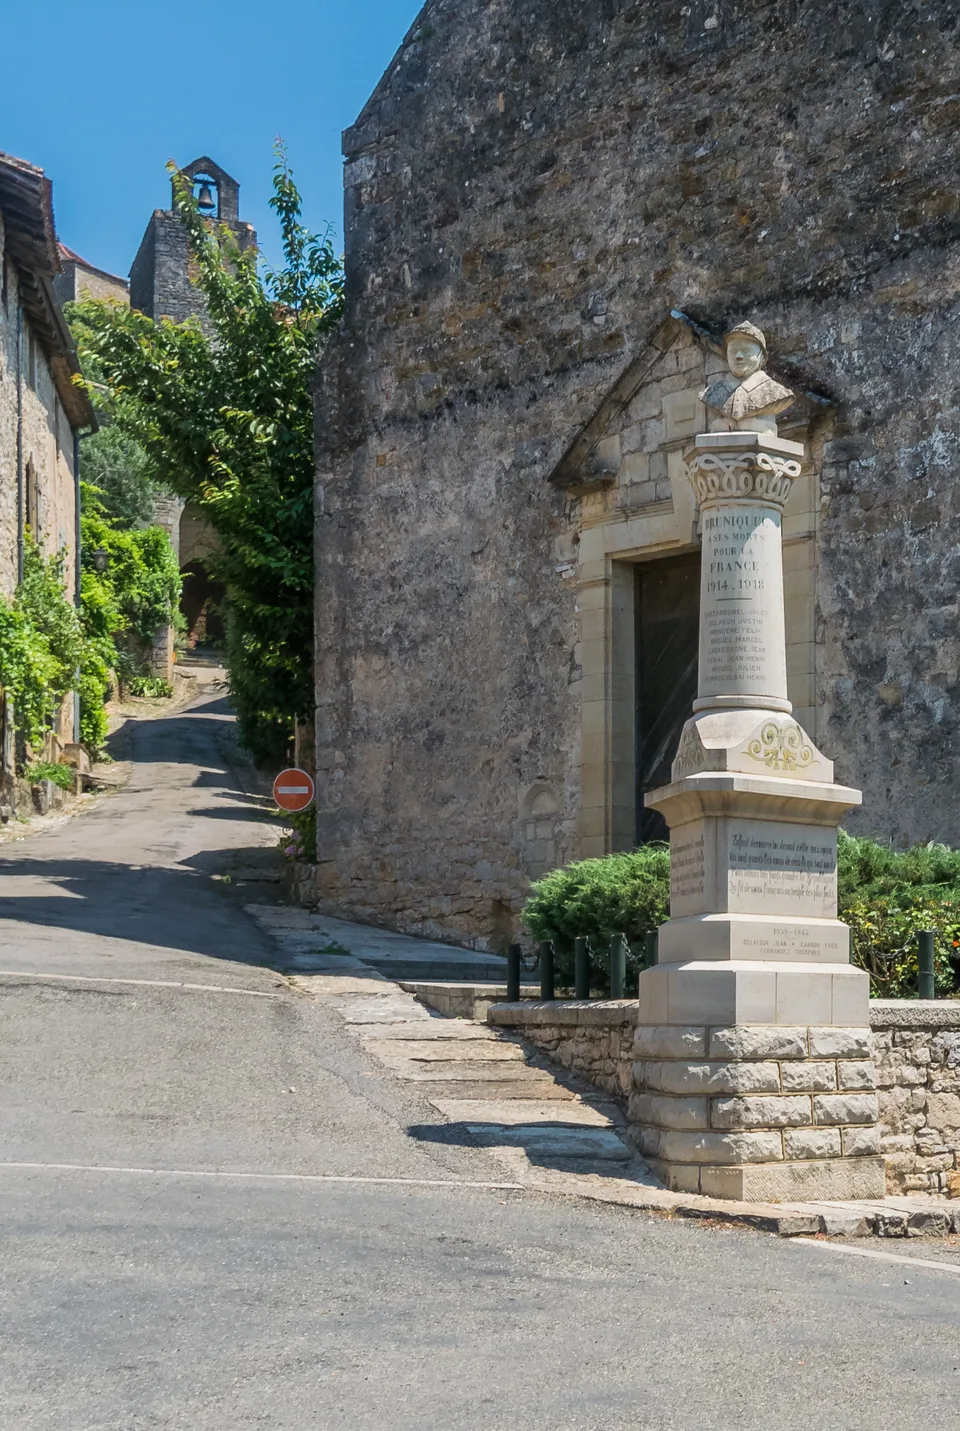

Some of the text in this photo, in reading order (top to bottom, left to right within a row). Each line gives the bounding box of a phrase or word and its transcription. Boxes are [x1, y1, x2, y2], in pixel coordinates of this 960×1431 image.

[713, 533, 729, 542] SES
[732, 532, 765, 541] MORTS
[713, 547, 754, 556] POUR LA
[709, 561, 760, 574] FRANCE
[735, 636, 762, 644] MARCEL
[736, 664, 761, 672] JULIEN
